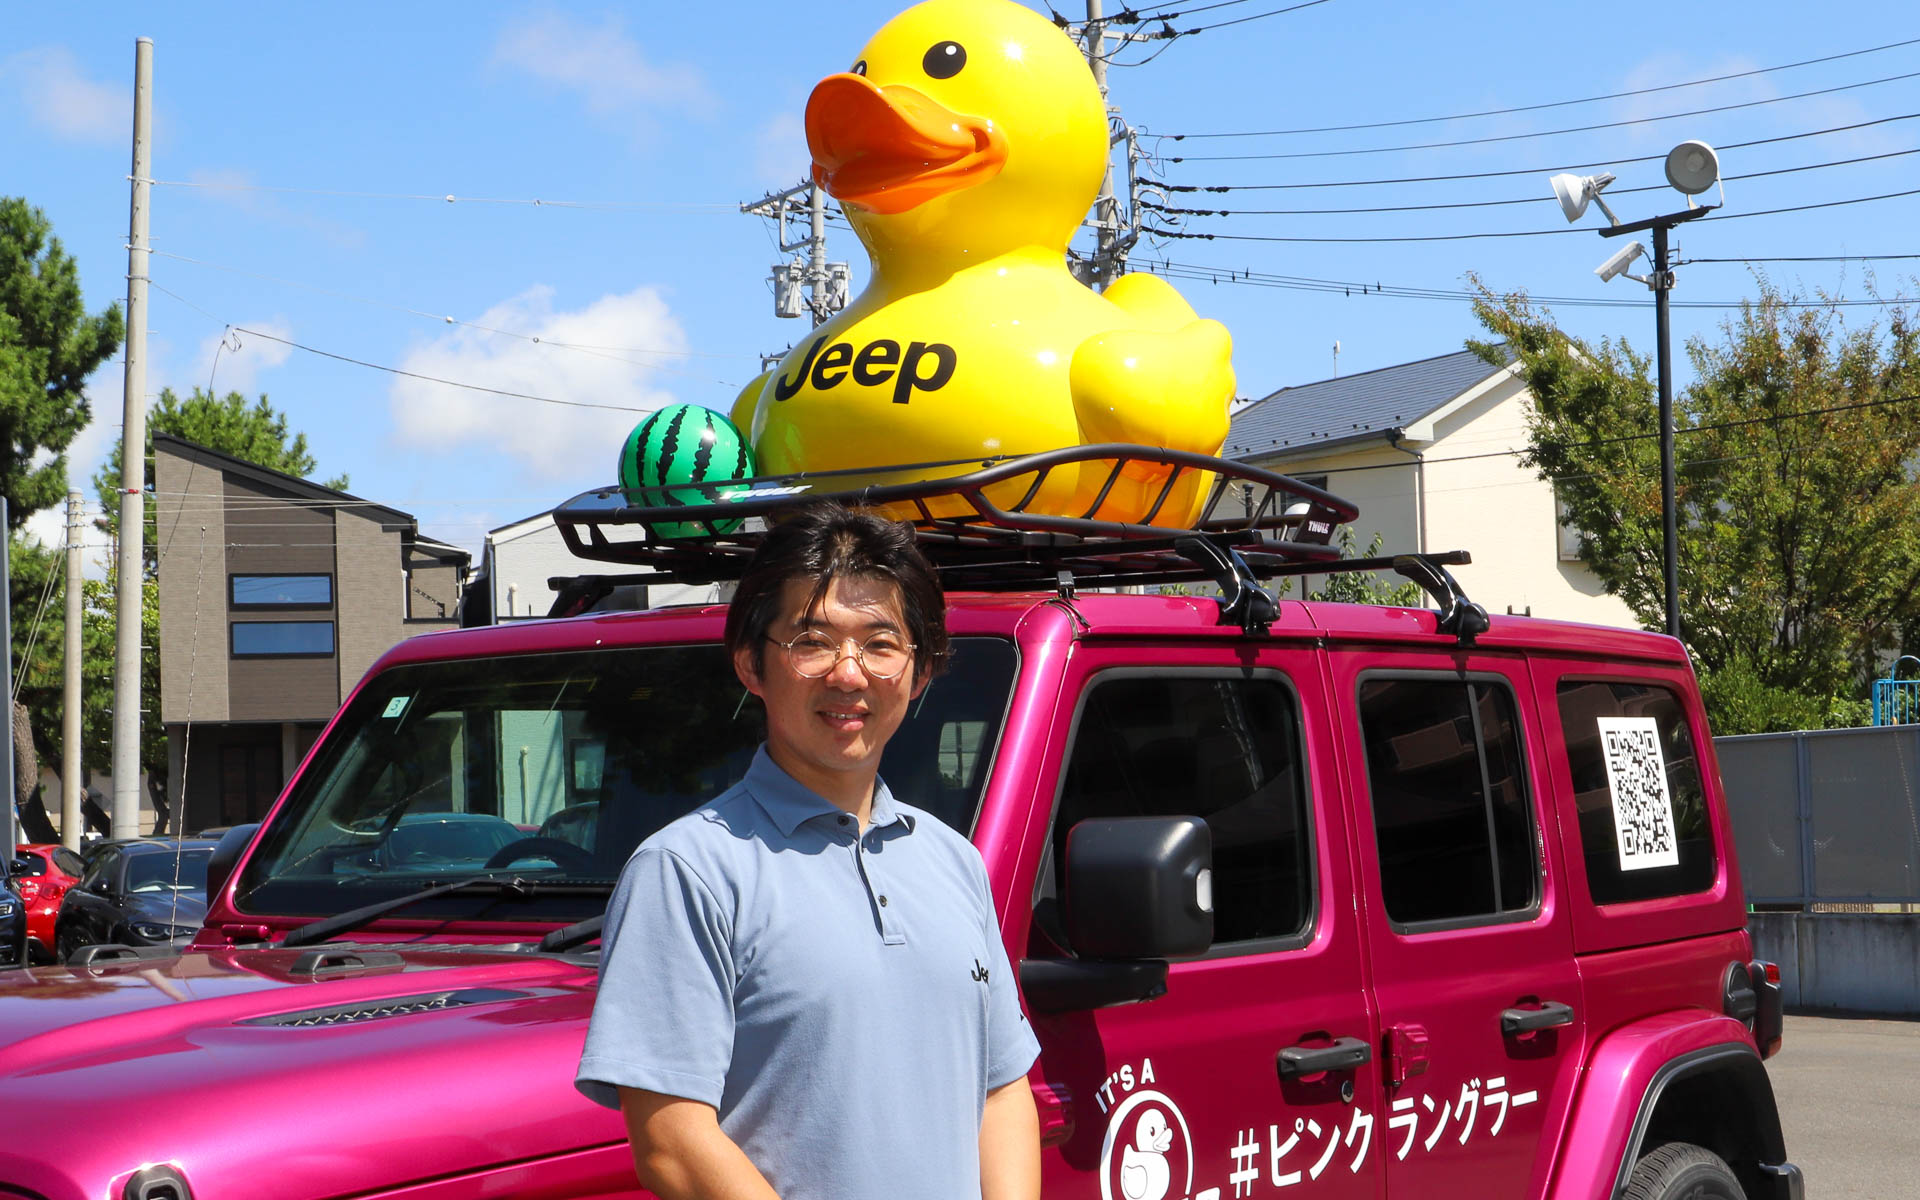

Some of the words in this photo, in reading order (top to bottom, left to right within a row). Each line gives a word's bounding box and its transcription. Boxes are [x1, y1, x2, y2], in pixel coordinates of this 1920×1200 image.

[775, 334, 957, 404] Jeep
[1308, 520, 1330, 535] THULE
[1094, 1064, 1135, 1114] IT'S
[1140, 1058, 1155, 1084] A
